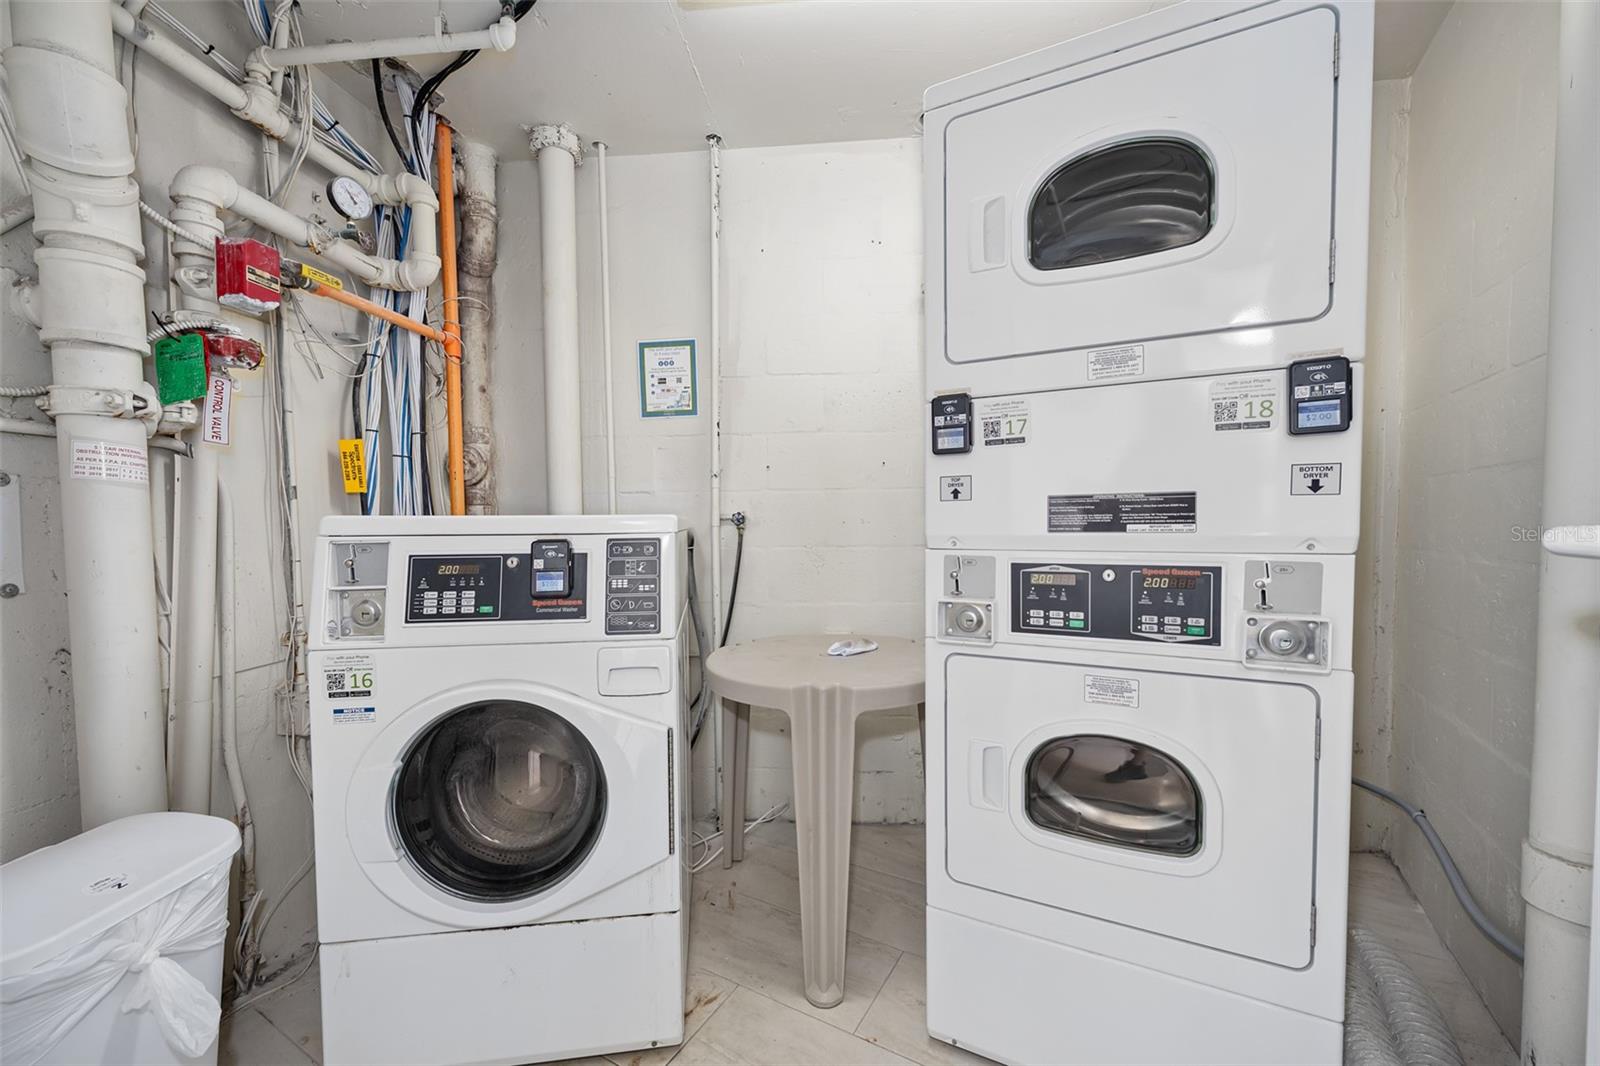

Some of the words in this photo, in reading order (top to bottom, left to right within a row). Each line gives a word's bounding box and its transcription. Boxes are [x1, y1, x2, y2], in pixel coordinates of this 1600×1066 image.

[214, 380, 224, 414] CONTROL
[1244, 400, 1274, 419] 18
[212, 417, 222, 440] VALVE
[1006, 418, 1027, 435] 17
[76, 448, 120, 456] OBSTRUTION
[438, 565, 459, 574] 2.00
[1031, 574, 1054, 584] 2.00
[1143, 578, 1168, 588] 2.00
[350, 672, 373, 688] 16
